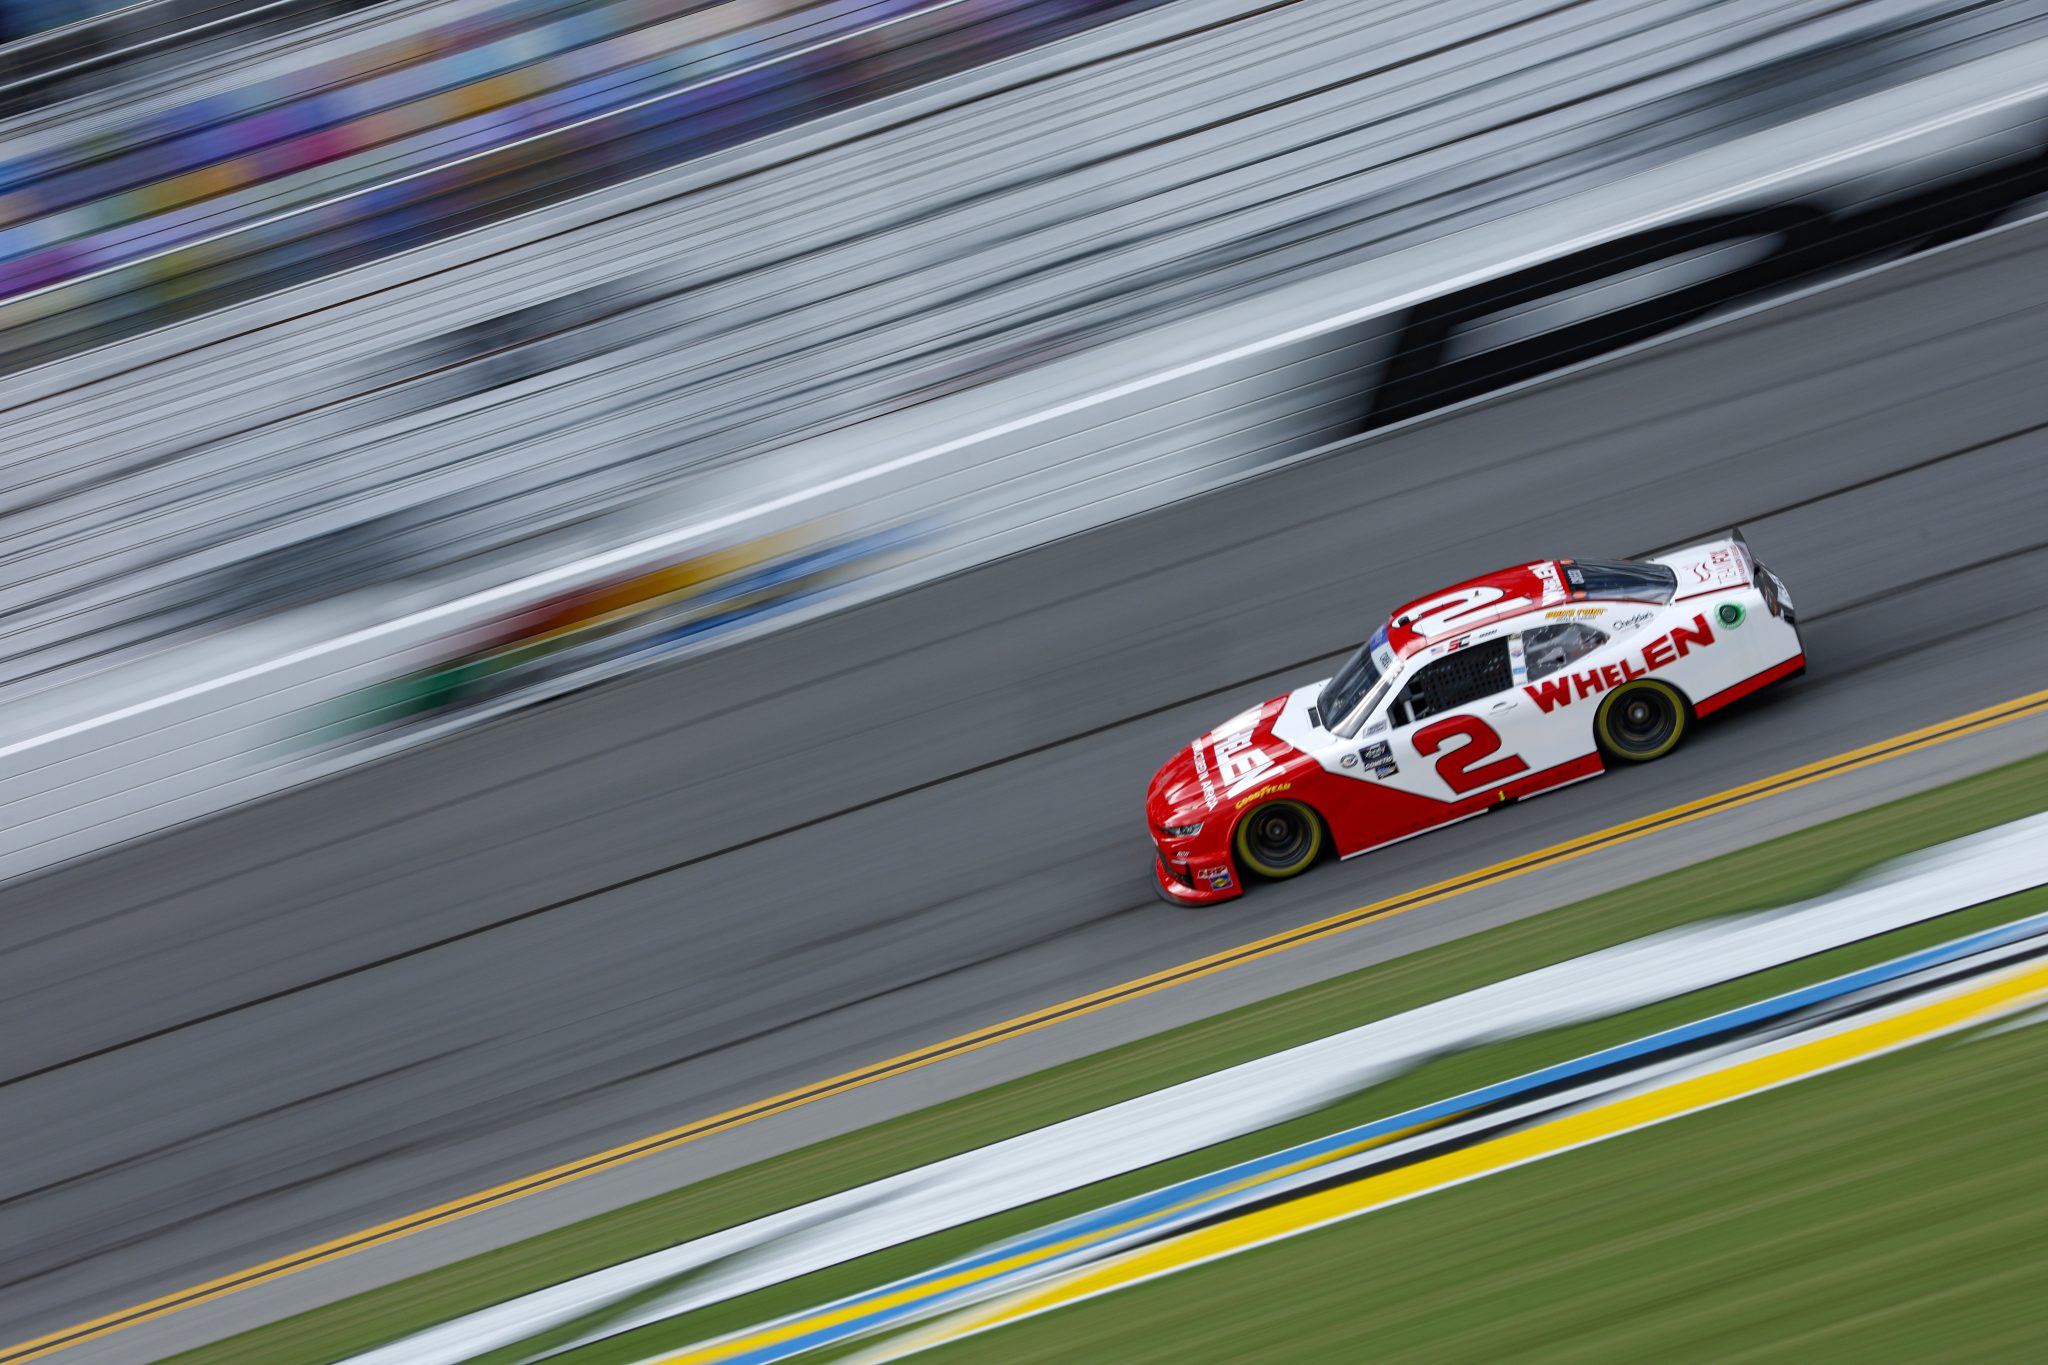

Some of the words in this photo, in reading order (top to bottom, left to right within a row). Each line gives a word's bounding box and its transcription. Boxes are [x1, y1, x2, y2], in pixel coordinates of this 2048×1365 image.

[1391, 586, 1533, 638] 2
[1528, 561, 1568, 607] WHELEN
[1523, 613, 1715, 714] WHELEN
[1211, 702, 1288, 799] WHELEN
[1412, 714, 1531, 795] 2
[1235, 783, 1291, 810] GOODYEAR
